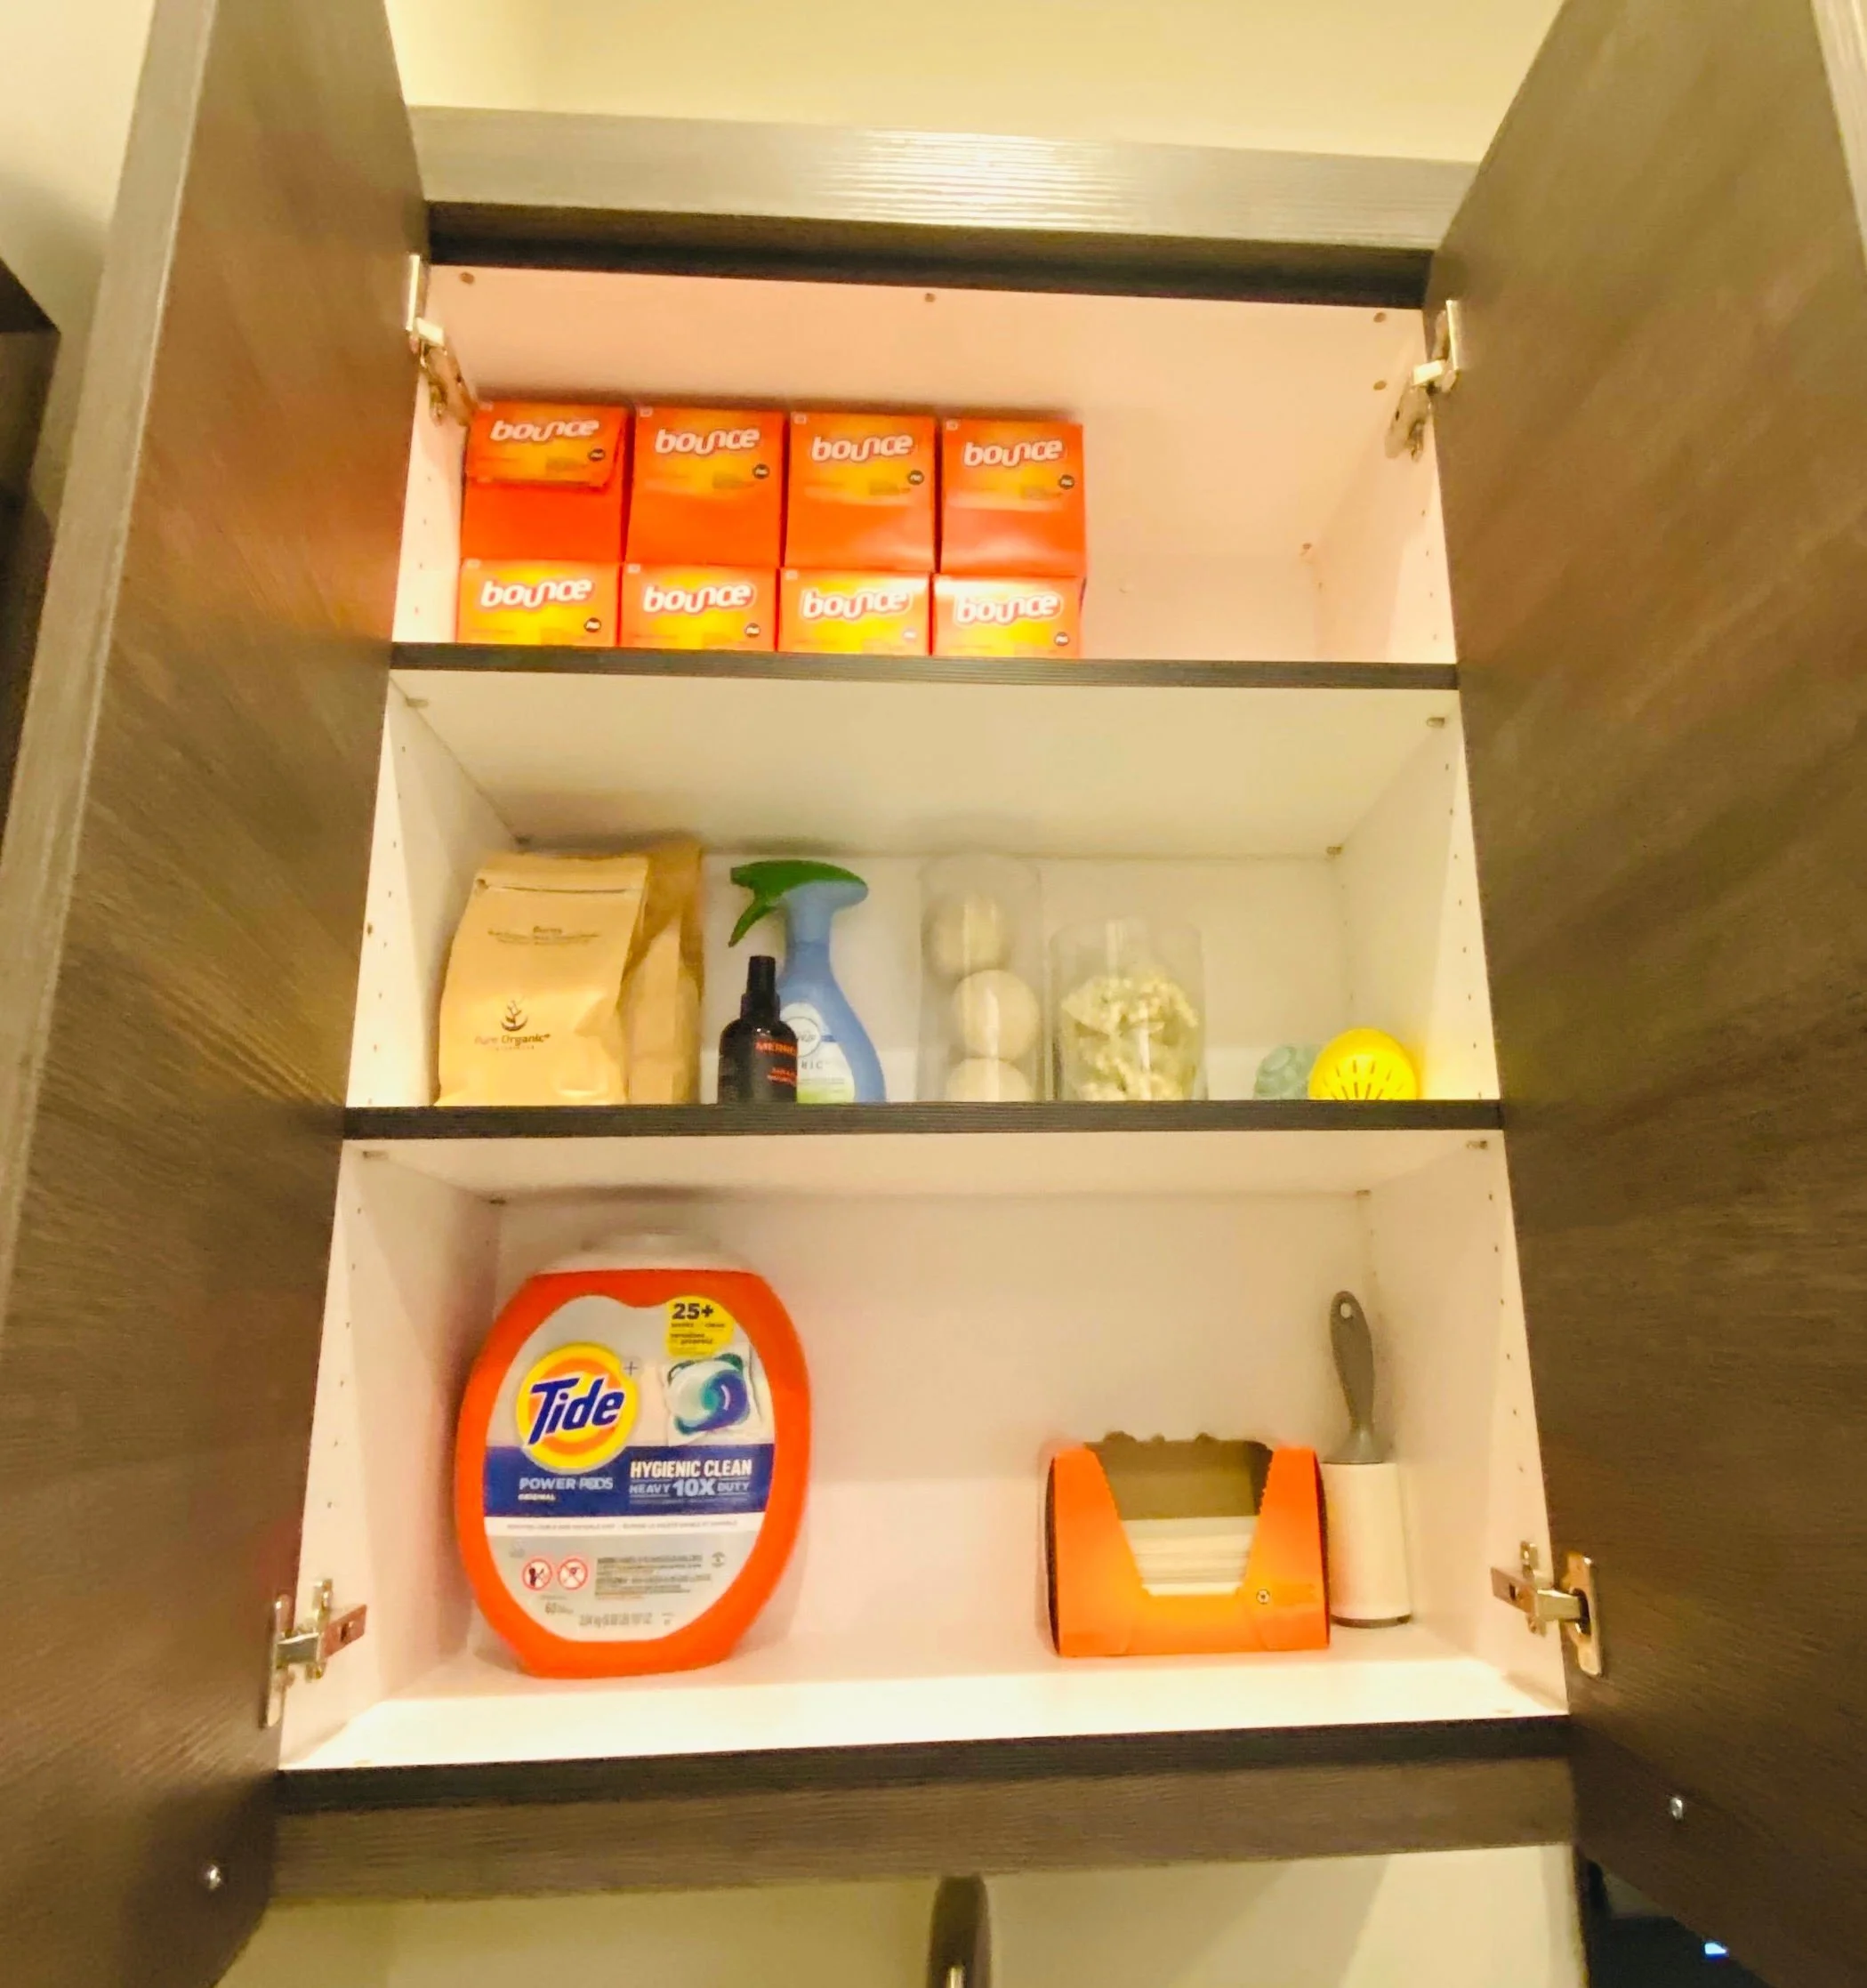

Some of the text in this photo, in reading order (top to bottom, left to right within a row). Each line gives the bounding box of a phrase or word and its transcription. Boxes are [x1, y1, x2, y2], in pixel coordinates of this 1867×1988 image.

[490, 420, 600, 441] bounce
[655, 429, 760, 455] bounce
[811, 434, 913, 462] bounce
[963, 439, 1063, 467] bounce
[480, 579, 592, 608] bounce
[643, 584, 754, 614] bounce
[802, 590, 911, 619] bounce
[956, 593, 1060, 624] bounce
[672, 1302, 713, 1320] 25+
[527, 1378, 625, 1445] Tide
[630, 1459, 752, 1478] HYGIENIC CLEAN
[519, 1477, 575, 1490] POWER
[629, 1477, 750, 1497] HEAVY 10X DUTY
